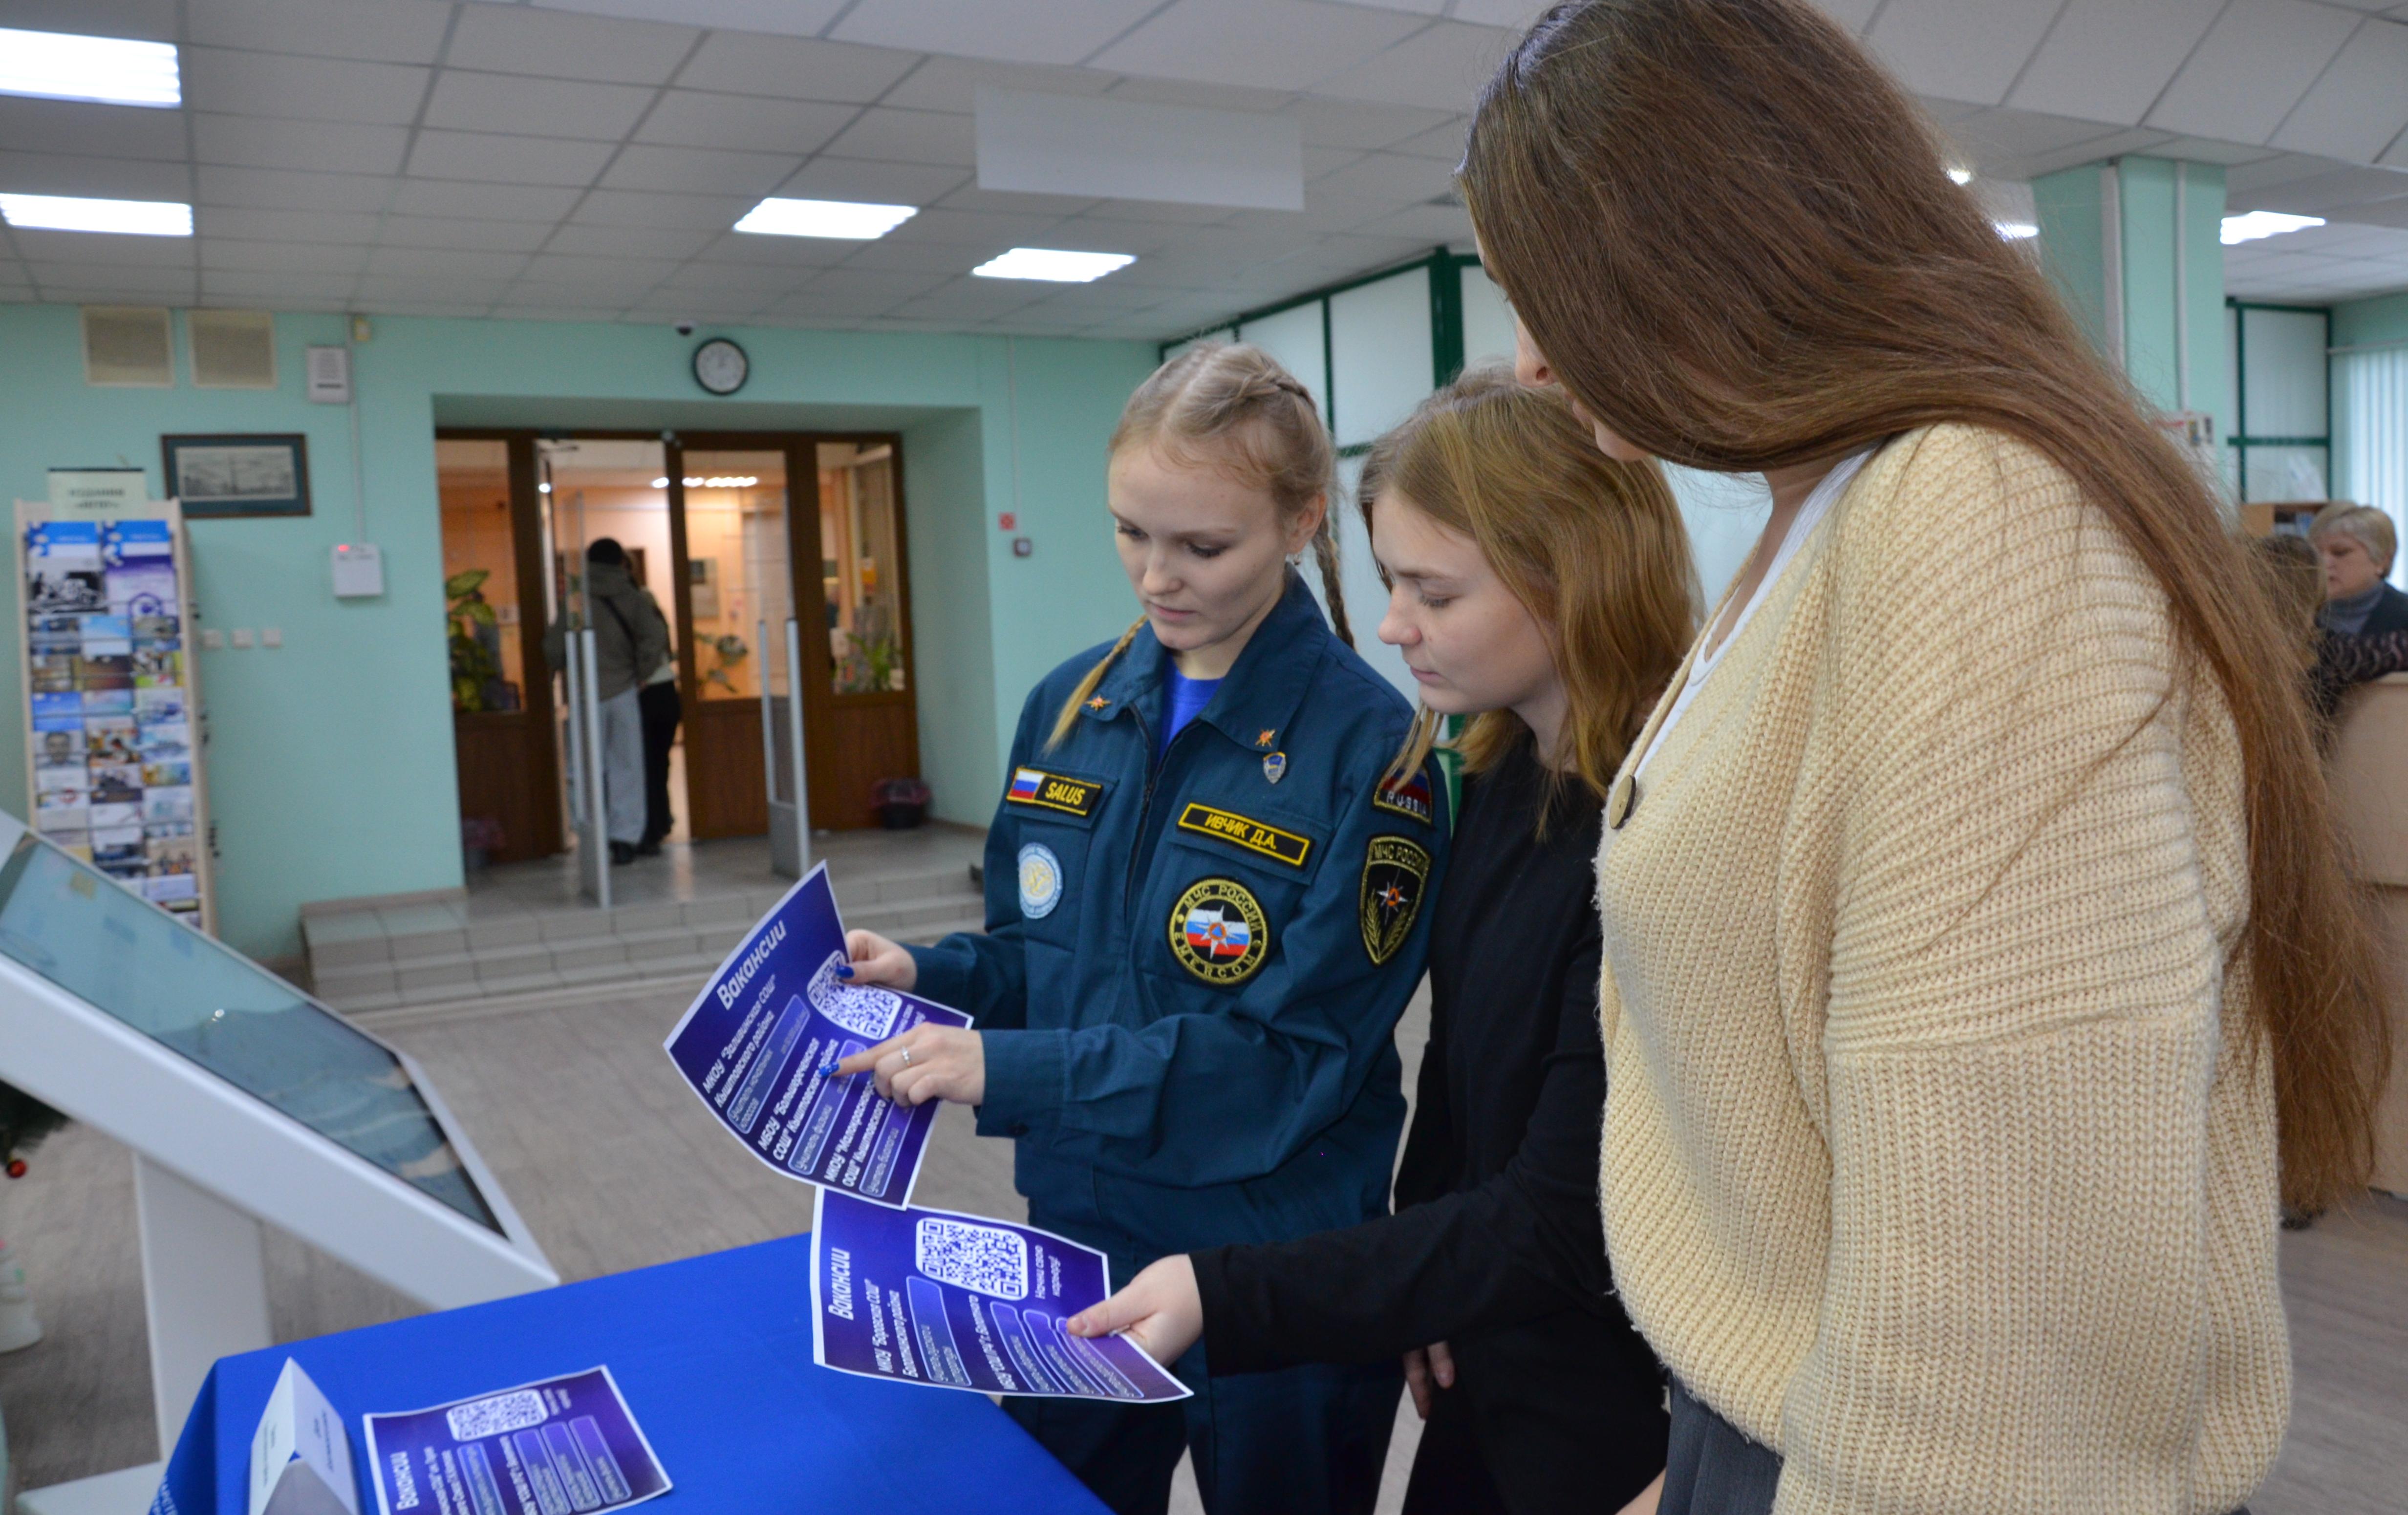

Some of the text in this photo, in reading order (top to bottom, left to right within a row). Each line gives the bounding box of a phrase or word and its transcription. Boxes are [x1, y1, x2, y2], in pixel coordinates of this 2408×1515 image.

[1045, 782, 1086, 805] SALUS
[1386, 790, 1427, 815] RUSSIA
[1204, 813, 1277, 850] ИВЧИК Д.А.
[1374, 843, 1394, 860] МЧС
[1183, 884, 1262, 932] МЧС РОССИИ
[716, 920, 787, 1010] Вакансии
[1174, 932, 1257, 979] EMERCOM
[702, 1059, 725, 1094] МКОУ
[714, 1010, 774, 1108] Кыштовского района
[731, 1086, 753, 1122] Учитель
[758, 1116, 780, 1151] МБОУ
[773, 1128, 793, 1161] СОШ"
[852, 1099, 886, 1163] Кыштовского
[795, 1133, 820, 1171] Учитель
[824, 1152, 846, 1182] МКОУ
[828, 1247, 854, 1321] Вакансии
[390, 1451, 419, 1511] Вакансии
